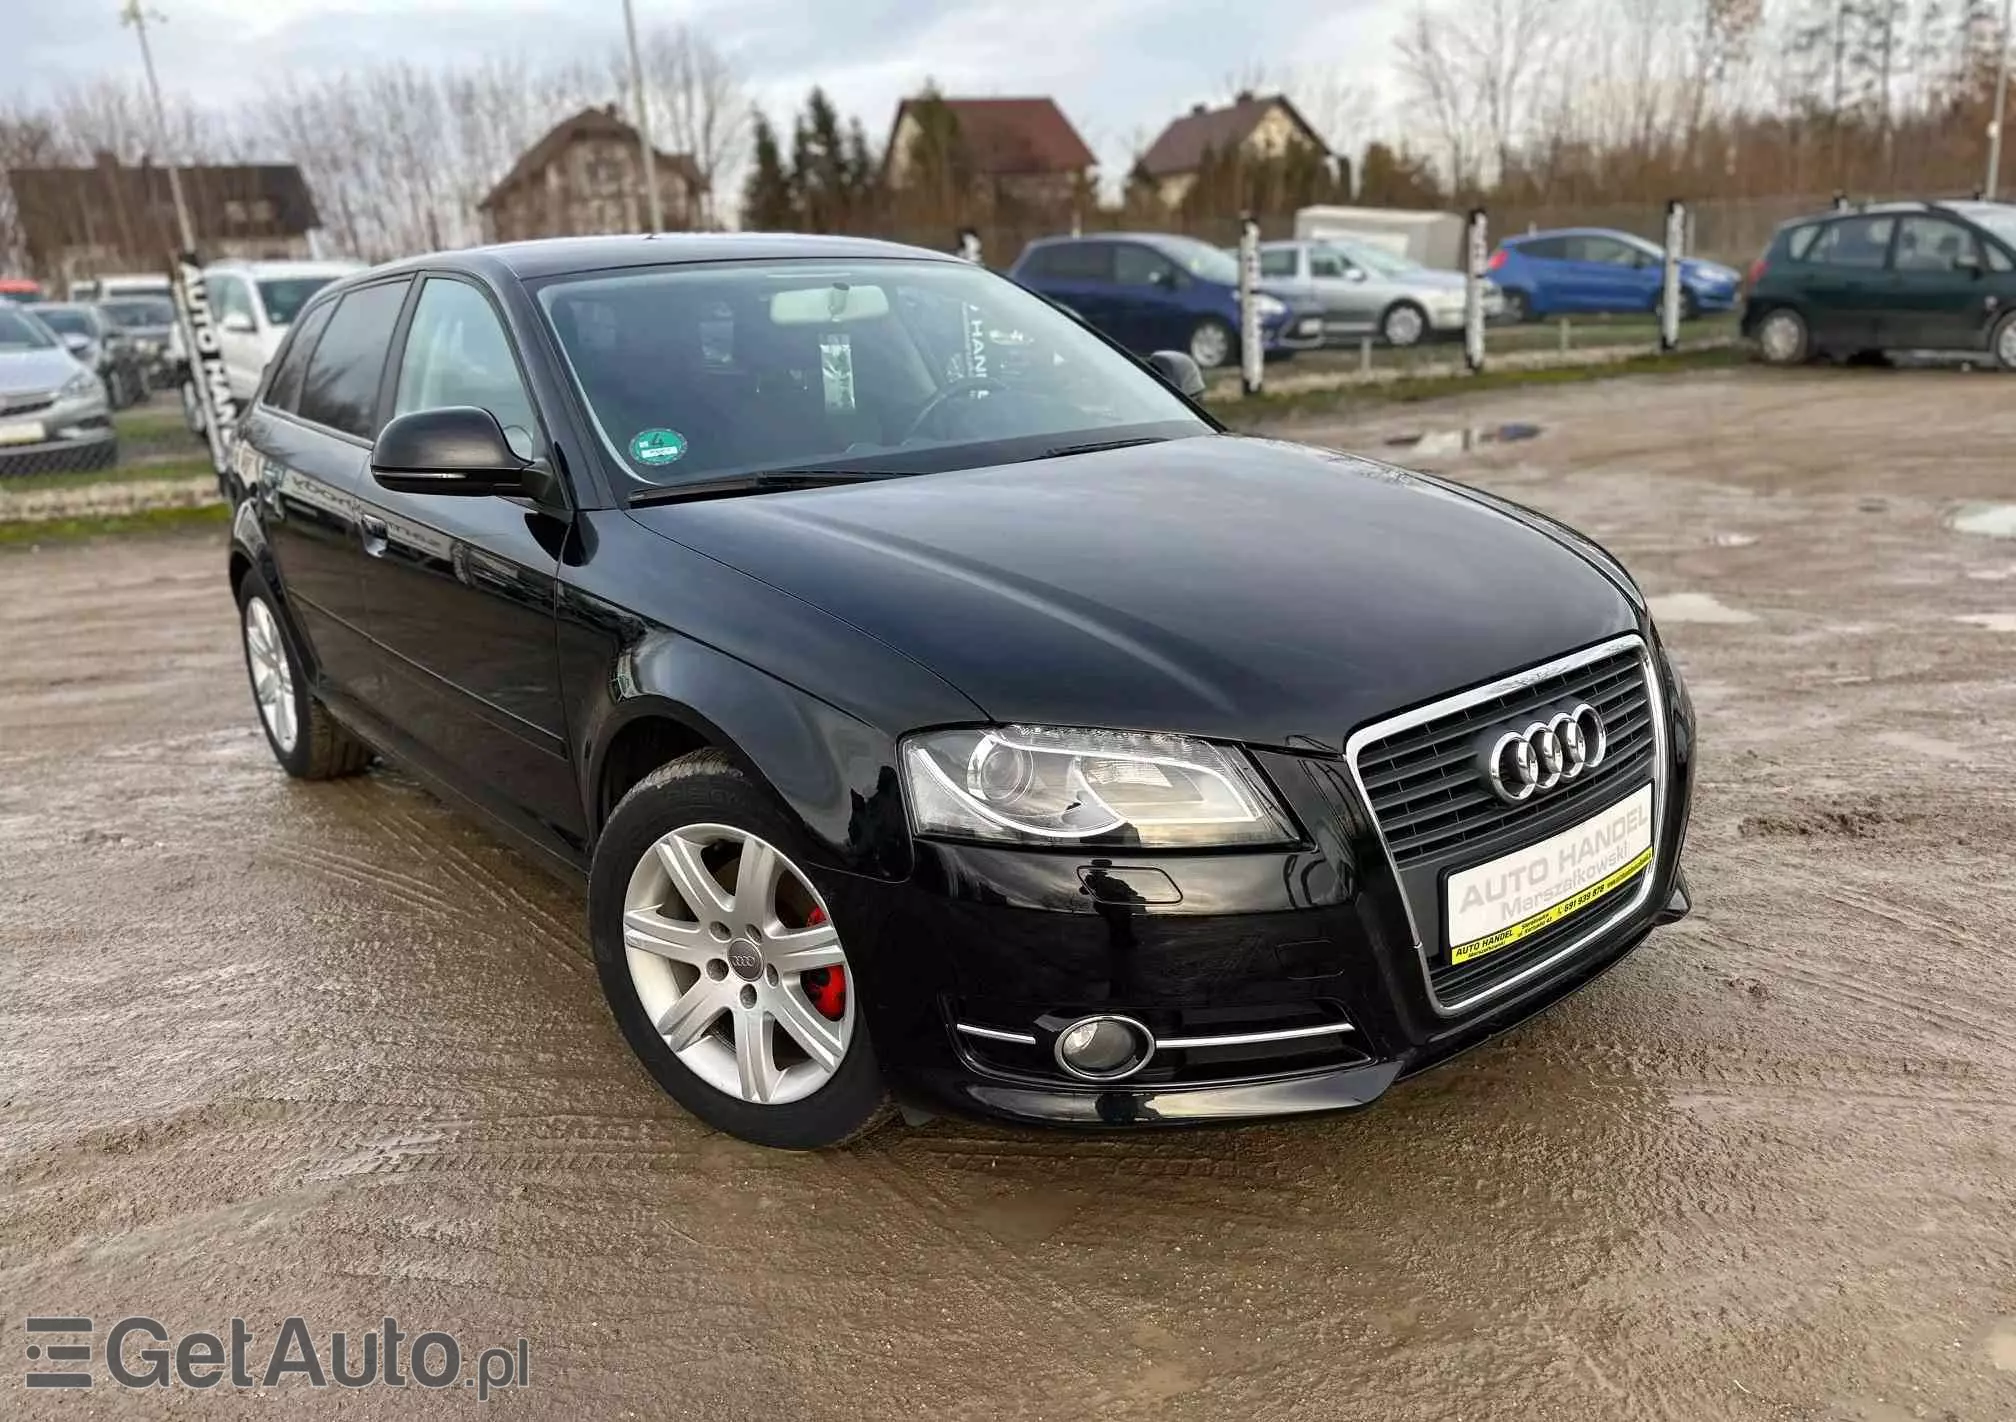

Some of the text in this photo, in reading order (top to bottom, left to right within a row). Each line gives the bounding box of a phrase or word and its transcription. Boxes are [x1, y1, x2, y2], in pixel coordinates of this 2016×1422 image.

[652, 432, 665, 447] 4
[1459, 857, 1549, 915] AUTO
[1559, 804, 1649, 873] HANDEL
[1455, 942, 1480, 957] AUTO
[1481, 928, 1513, 948] HANDEL
